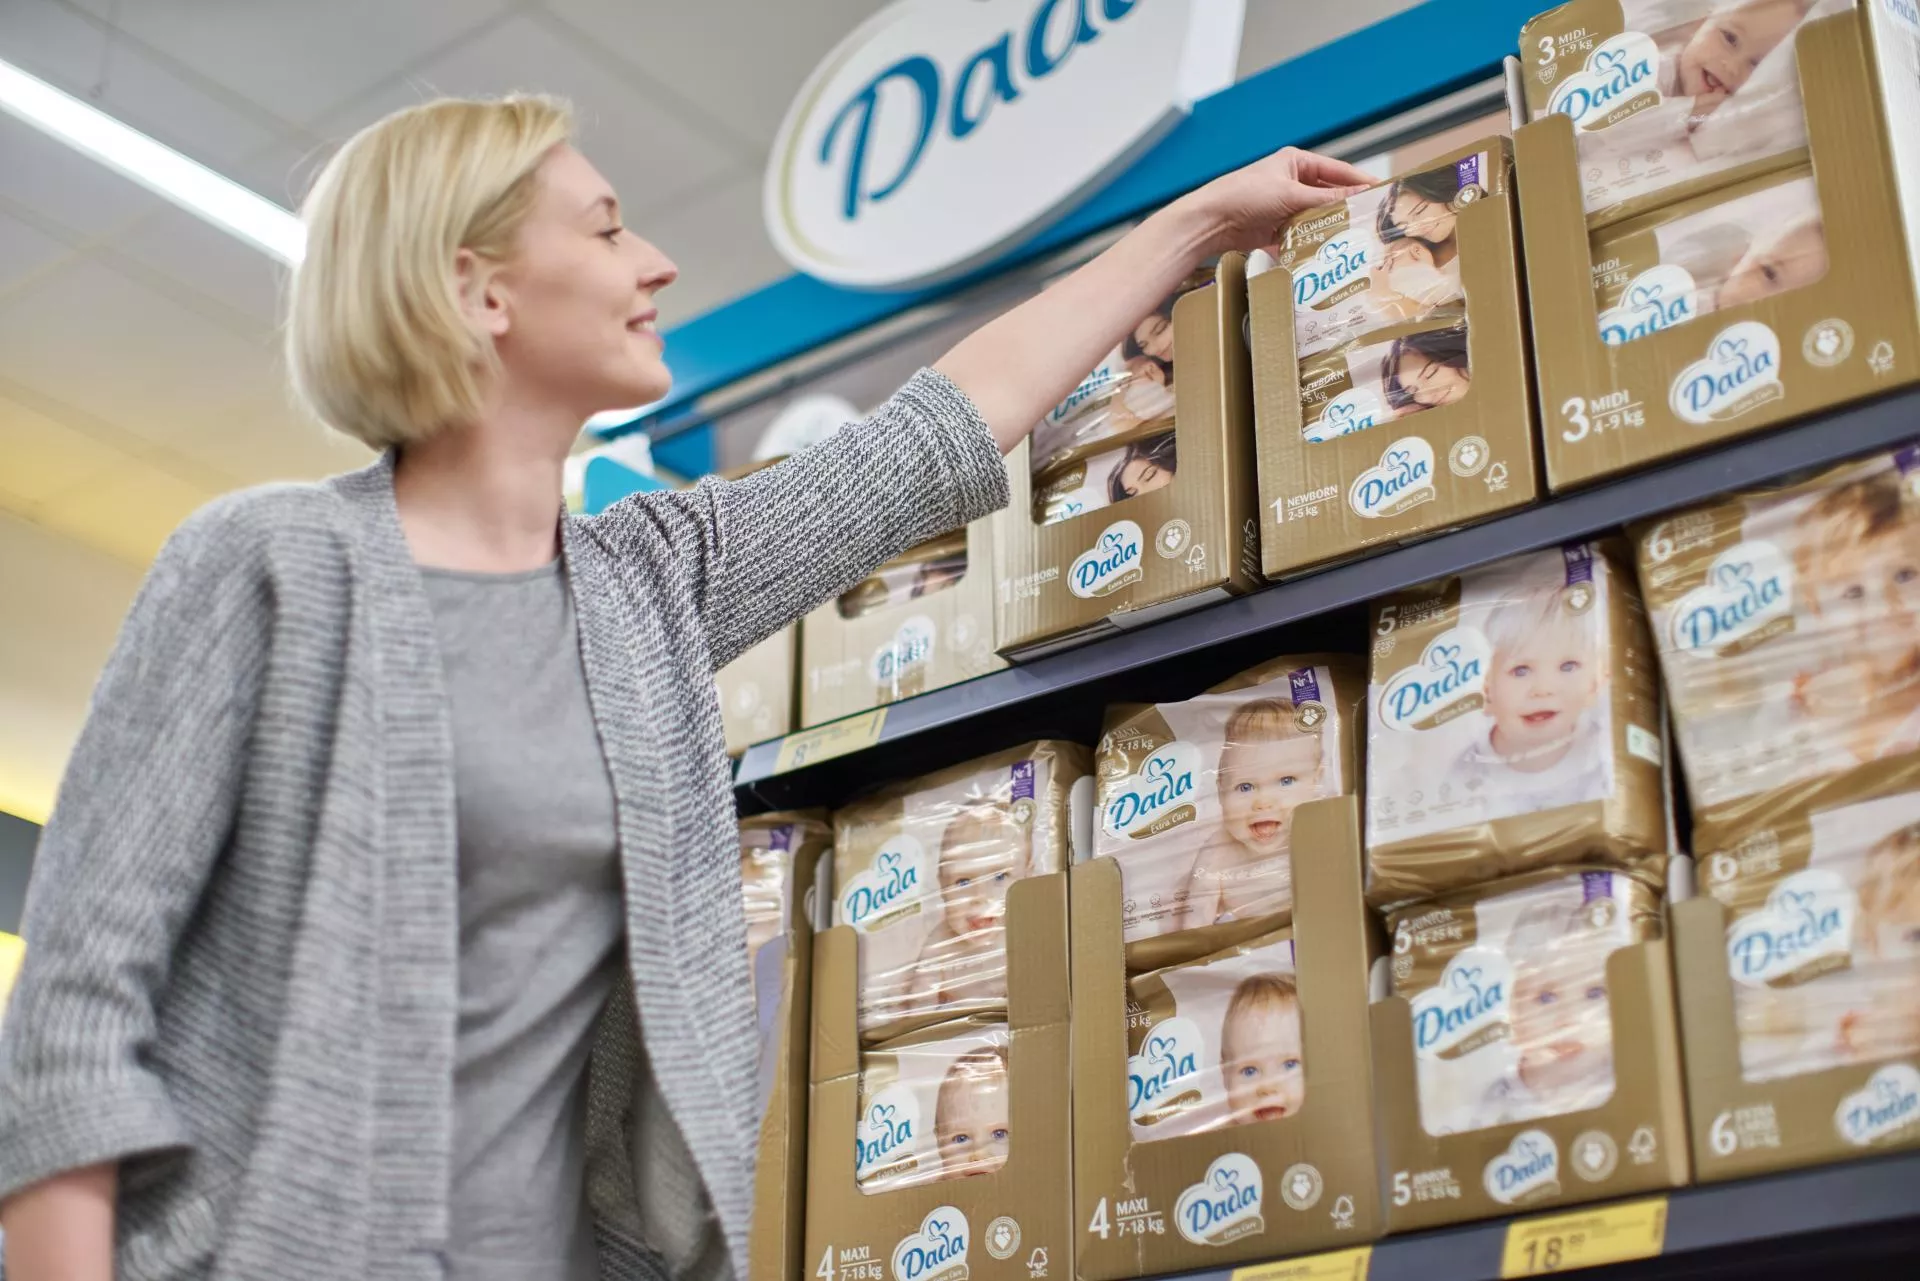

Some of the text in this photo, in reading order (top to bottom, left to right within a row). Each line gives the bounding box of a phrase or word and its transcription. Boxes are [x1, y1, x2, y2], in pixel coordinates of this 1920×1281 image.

[1538, 36, 1556, 65] 3
[1558, 27, 1586, 45] MIDI
[1579, 39, 1593, 50] kg
[1557, 59, 1652, 122] Dada
[815, 0, 1147, 221] Dad
[1607, 96, 1652, 124] Extra Care
[1295, 212, 1345, 236] NEWBORN
[1313, 232, 1325, 243] kg
[1294, 250, 1367, 305] Dada
[1330, 281, 1365, 304] Extra Care
[1314, 391, 1328, 402] kg
[1683, 350, 1774, 412] Dada
[1590, 389, 1630, 414] MIDI
[1561, 397, 1590, 442] 3
[1593, 409, 1645, 435] 4-9 kg
[1287, 484, 1338, 508] NEWBORN
[1357, 459, 1429, 509] Dada
[1269, 496, 1284, 524] 1
[1287, 504, 1319, 521] 2-5 kg
[1649, 521, 1673, 562] 6
[1076, 541, 1138, 589] Dada
[1376, 605, 1397, 636] 5
[1399, 597, 1443, 618] JUNIOR
[1681, 575, 1784, 649] Dada
[1388, 658, 1480, 721] Dada
[1102, 732, 1114, 756] 4
[1117, 738, 1155, 751] 7-18 kg
[1109, 771, 1193, 830] Dada
[1150, 809, 1190, 834] Extra Care
[846, 866, 917, 923] Dada
[1393, 918, 1413, 954] 5
[1733, 908, 1841, 975] Dada
[1139, 1015, 1152, 1028] kg
[1413, 981, 1503, 1049] Dada
[1710, 1111, 1738, 1156] 6
[1392, 1170, 1412, 1206] 5
[1088, 1197, 1111, 1240] 4
[1116, 1197, 1148, 1217] MAXI
[1186, 1183, 1258, 1233] Dada
[1117, 1217, 1165, 1237] 7-18 kg
[816, 1244, 835, 1281] 4
[840, 1246, 870, 1264] MAXI
[901, 1234, 965, 1280] Dada
[1523, 1236, 1563, 1273] 18
[840, 1263, 883, 1281] 7-18 kg
